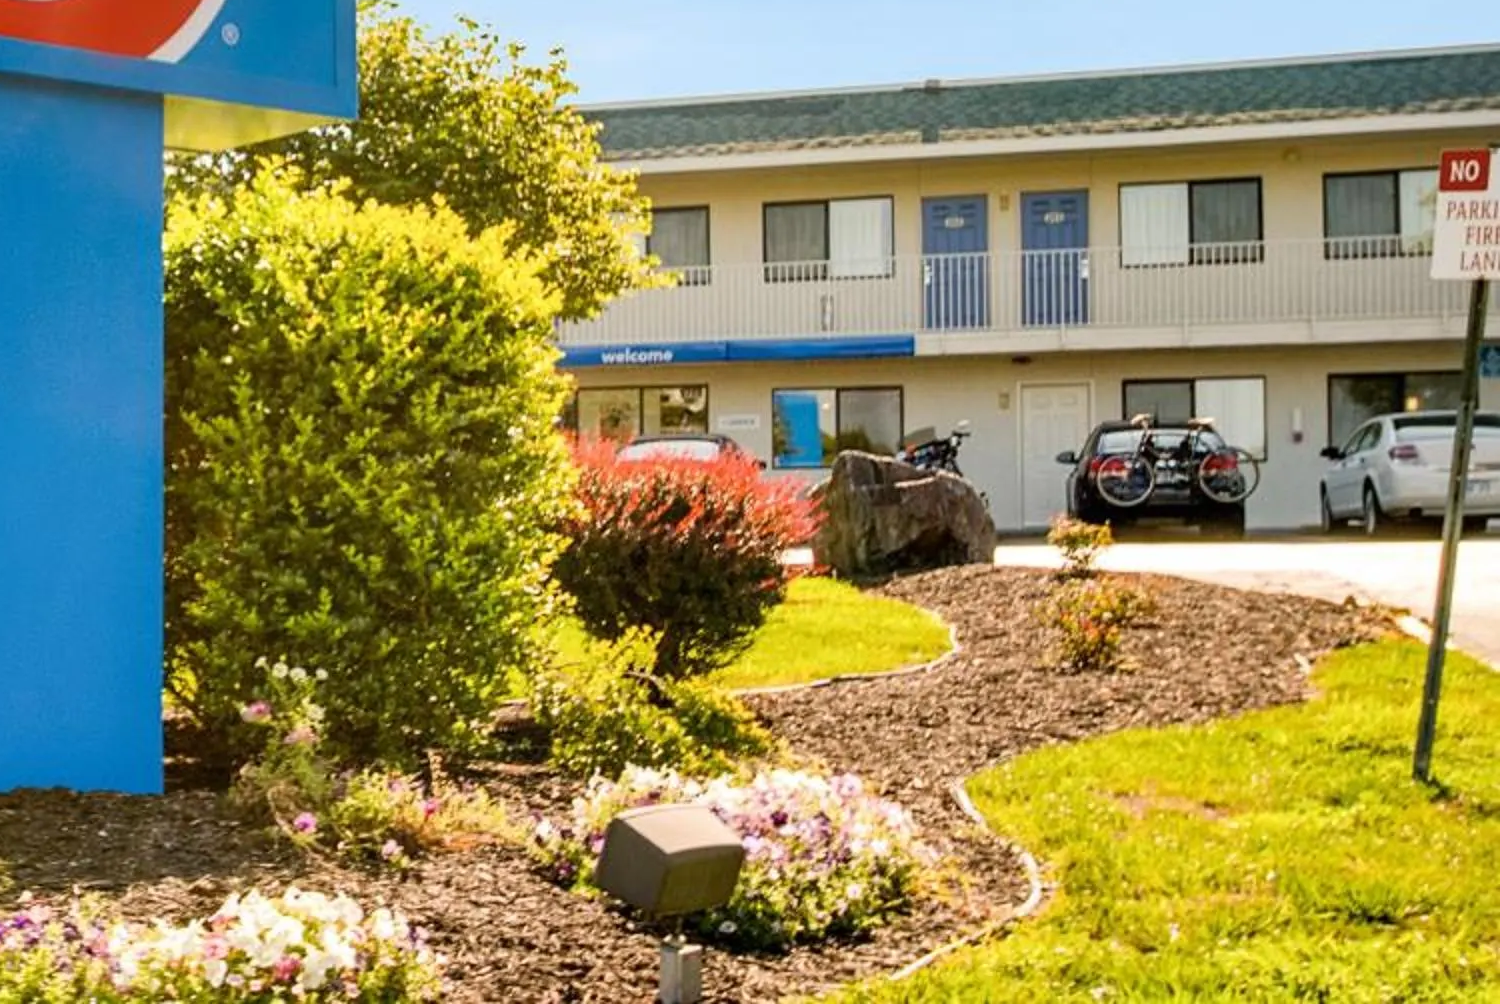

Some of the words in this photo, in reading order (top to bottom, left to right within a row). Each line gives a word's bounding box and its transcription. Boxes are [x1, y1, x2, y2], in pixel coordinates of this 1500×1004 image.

[1449, 159, 1480, 183] NO
[1460, 250, 1500, 272] LAN
[601, 347, 674, 365] welcome
